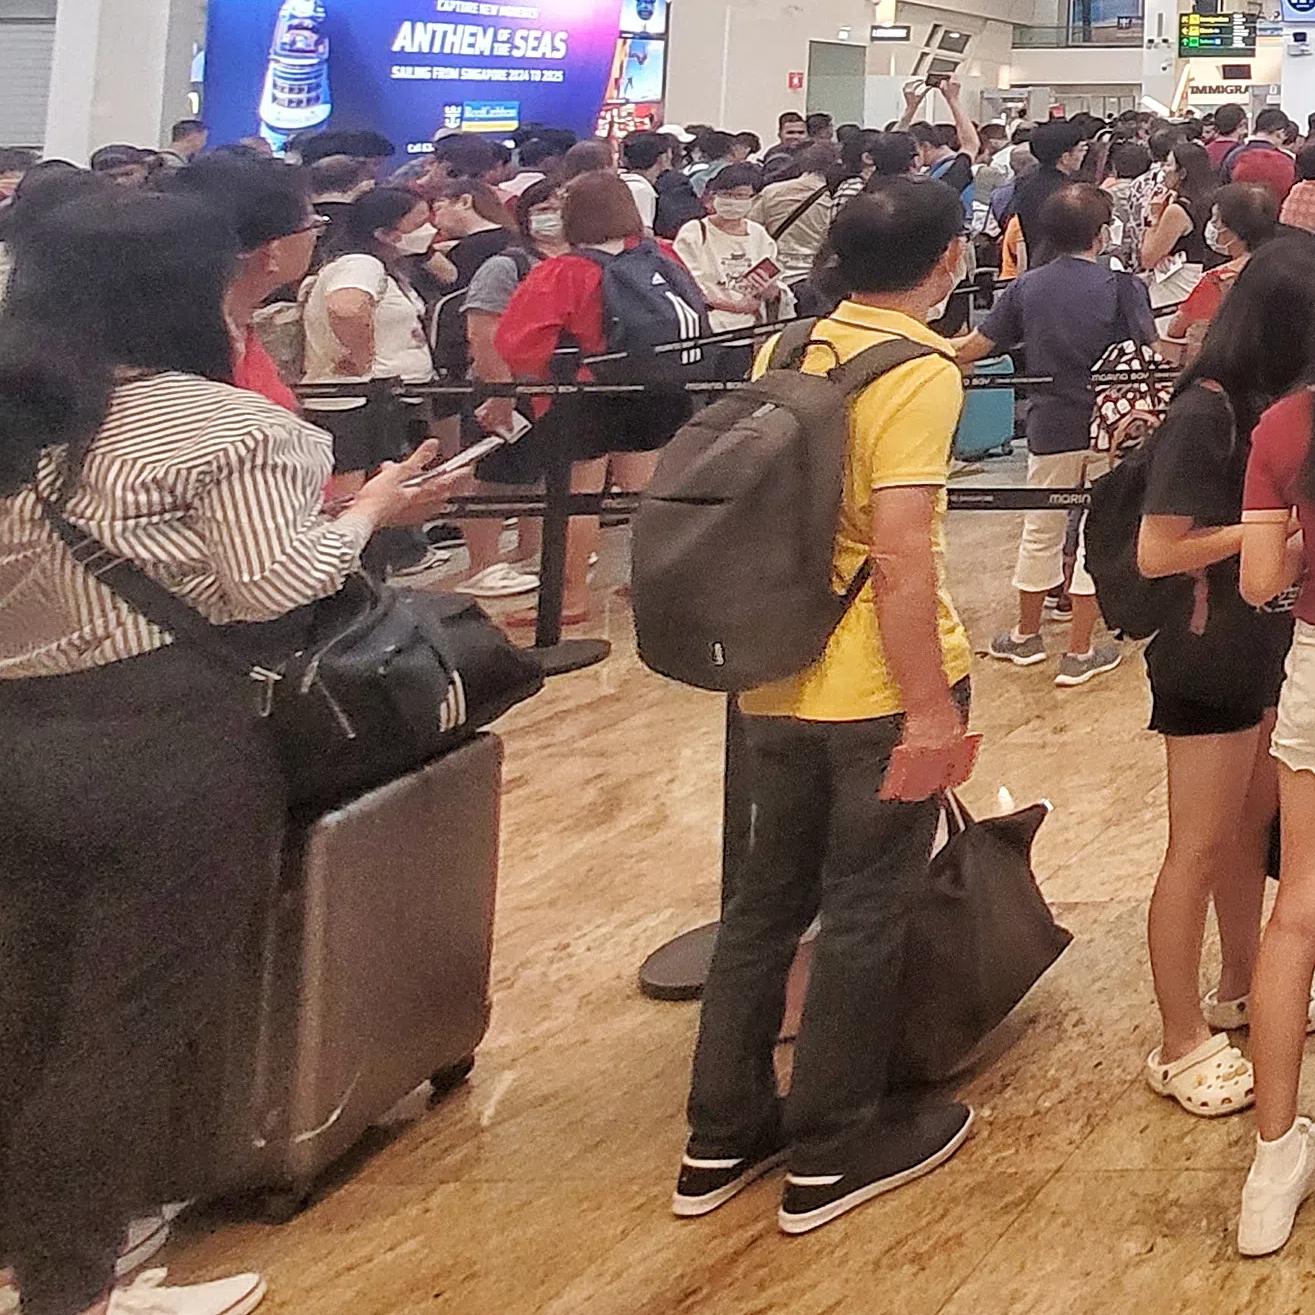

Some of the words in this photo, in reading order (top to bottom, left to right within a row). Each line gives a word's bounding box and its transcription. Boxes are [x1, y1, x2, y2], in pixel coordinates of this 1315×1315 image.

[391, 21, 495, 56] ANTHEM
[512, 29, 568, 59] SEAS
[390, 65, 432, 80] SAILING
[432, 66, 459, 80] FROM
[1050, 493, 1091, 504] MARIN
